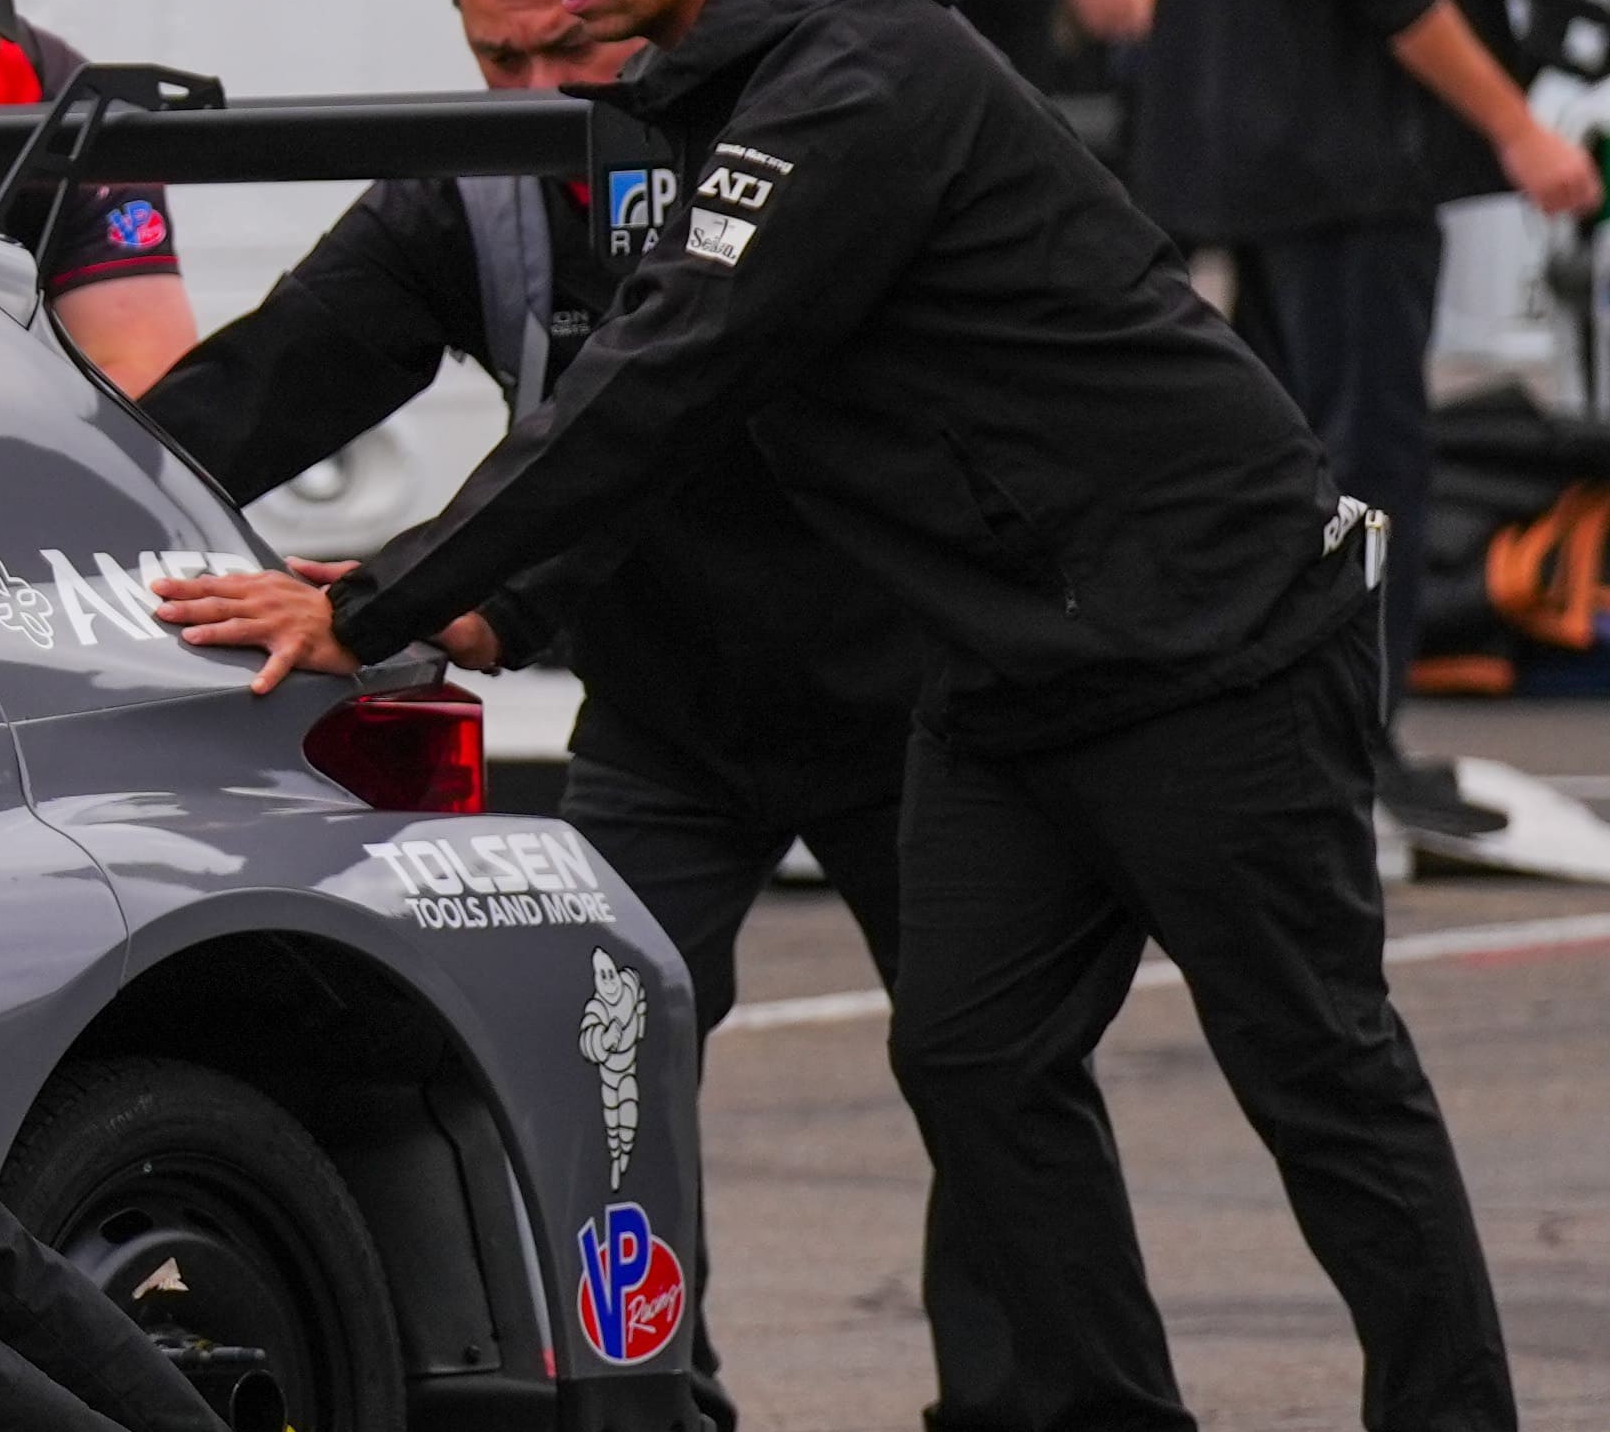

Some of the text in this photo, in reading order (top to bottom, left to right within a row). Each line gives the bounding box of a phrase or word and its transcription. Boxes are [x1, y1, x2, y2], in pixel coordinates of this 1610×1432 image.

[362, 830, 599, 896] TOLSEN
[404, 890, 617, 930] TOOLS AND MORE
[577, 1200, 653, 1360] VP
[627, 1282, 683, 1344] Racing
